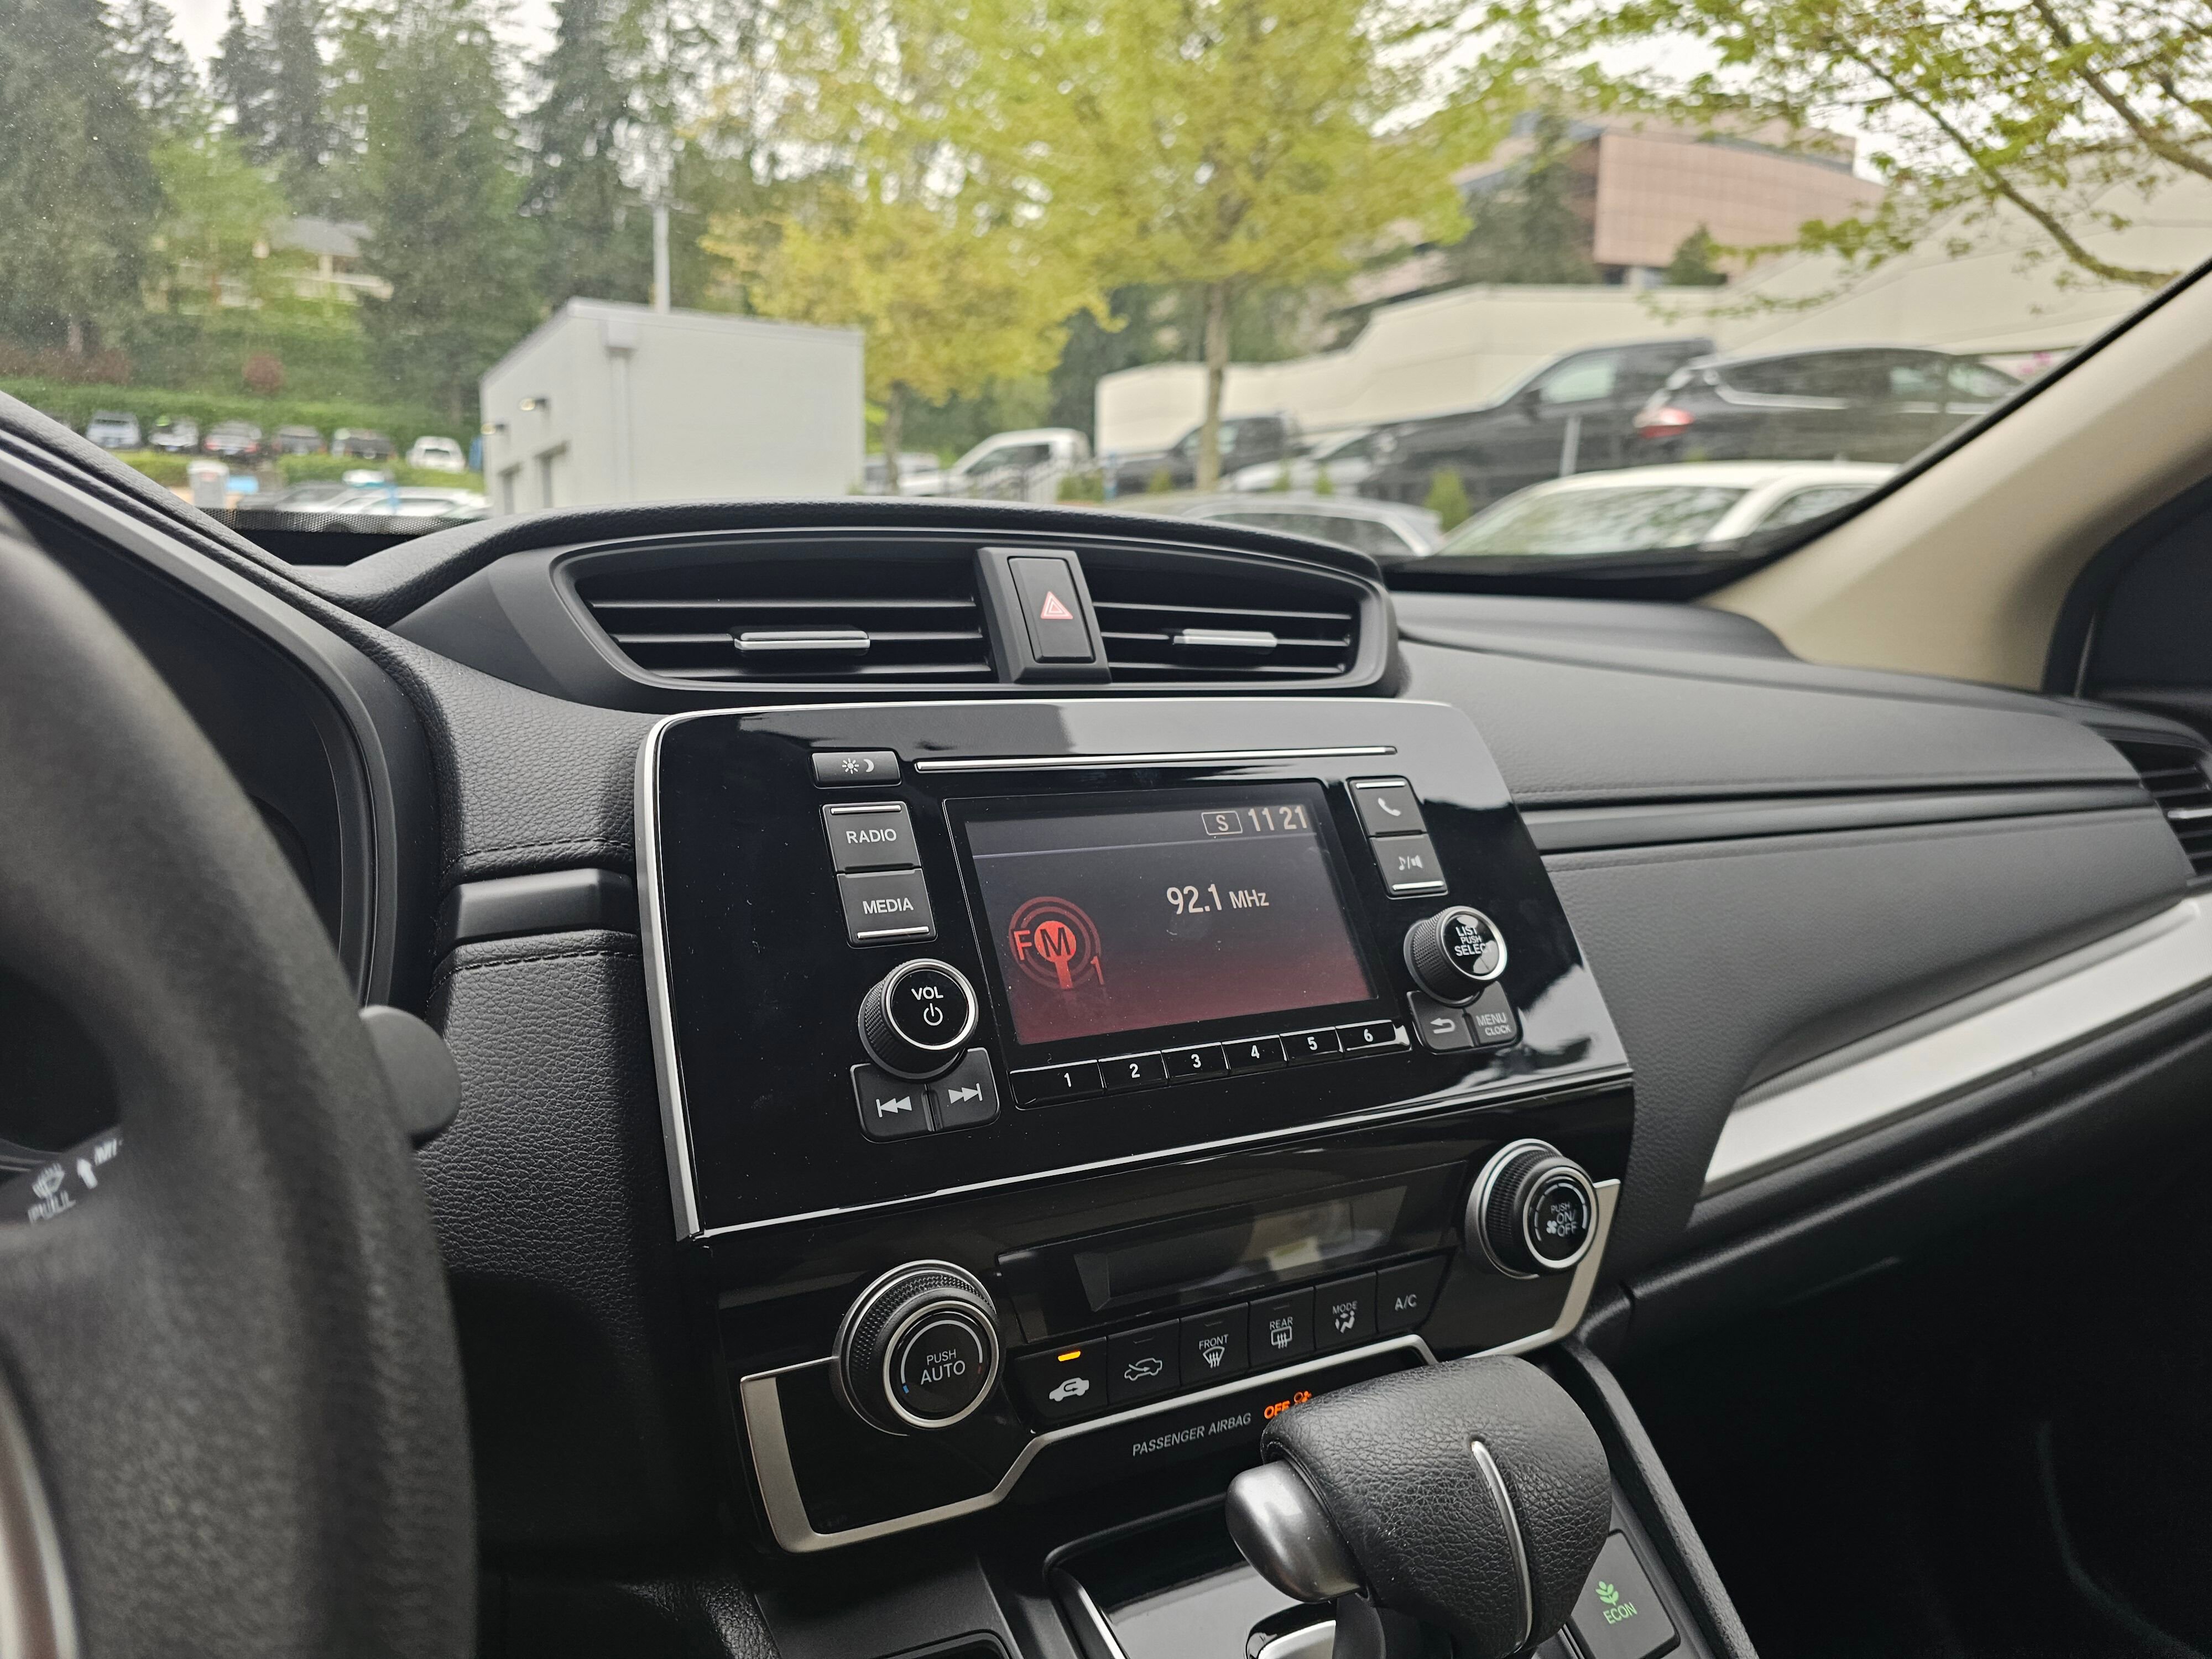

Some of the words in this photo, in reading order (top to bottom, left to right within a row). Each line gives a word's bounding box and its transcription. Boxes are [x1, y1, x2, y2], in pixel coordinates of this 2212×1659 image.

[1216, 814, 1229, 832] S
[845, 828, 898, 844] RADIO
[862, 897, 914, 915] MEDIA
[1166, 884, 1222, 915] 92.1
[1229, 889, 1270, 909] MHz
[1455, 926, 1478, 937] LIST
[1460, 935, 1483, 945] PUSH
[1013, 927, 1072, 961] FM
[1089, 955, 1105, 985] 1
[911, 985, 945, 1001] VOL
[1475, 1011, 1507, 1027] MENU
[1363, 1029, 1374, 1043] 6
[1484, 1024, 1511, 1037] CLOCK
[1307, 1036, 1318, 1051] 5
[1250, 1045, 1260, 1059] 4
[1190, 1053, 1202, 1068] 3
[1129, 1063, 1140, 1079] 2
[1063, 1072, 1072, 1088] 1
[28, 1190, 76, 1224] PULL
[1550, 1201, 1571, 1214] PUSH
[1557, 1221, 1578, 1238] OFF
[1332, 1300, 1358, 1315] MODE
[1394, 1293, 1418, 1312] A/C
[1269, 1316, 1294, 1331] REAR
[1198, 1333, 1229, 1350] FRONT
[926, 1348, 957, 1366] PUSH
[920, 1359, 967, 1385] AUTO
[1132, 1425, 1206, 1457] PASSENGER
[1208, 1412, 1251, 1436] AIRBAG
[1602, 1601, 1638, 1625] ECON
